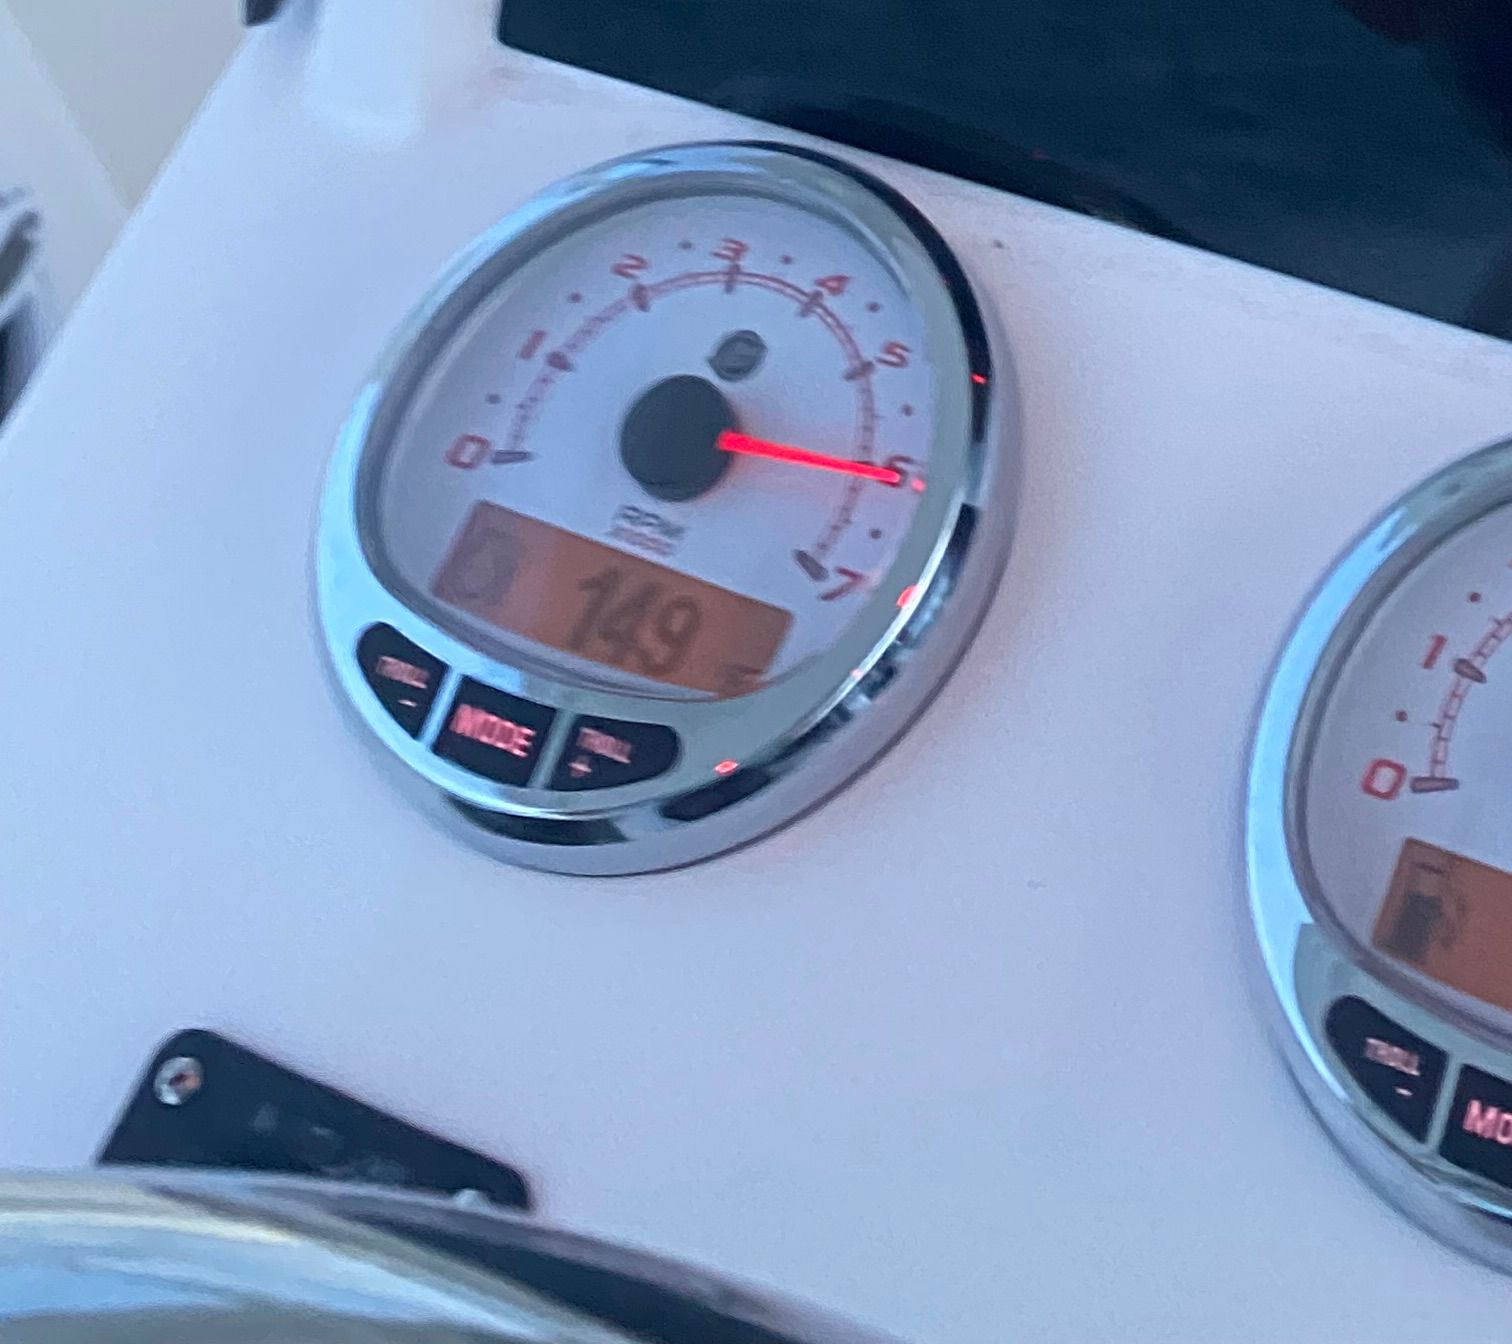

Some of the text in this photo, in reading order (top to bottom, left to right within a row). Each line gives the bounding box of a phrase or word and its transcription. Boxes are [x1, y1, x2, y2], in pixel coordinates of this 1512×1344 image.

[712, 238, 749, 262] 3
[611, 254, 650, 280] 2
[816, 273, 851, 296] 4
[516, 331, 547, 360] 1
[878, 343, 910, 368] 5
[444, 434, 491, 470] 0
[820, 569, 865, 601] 7
[1419, 634, 1447, 670] 1
[1361, 760, 1407, 802] 0
